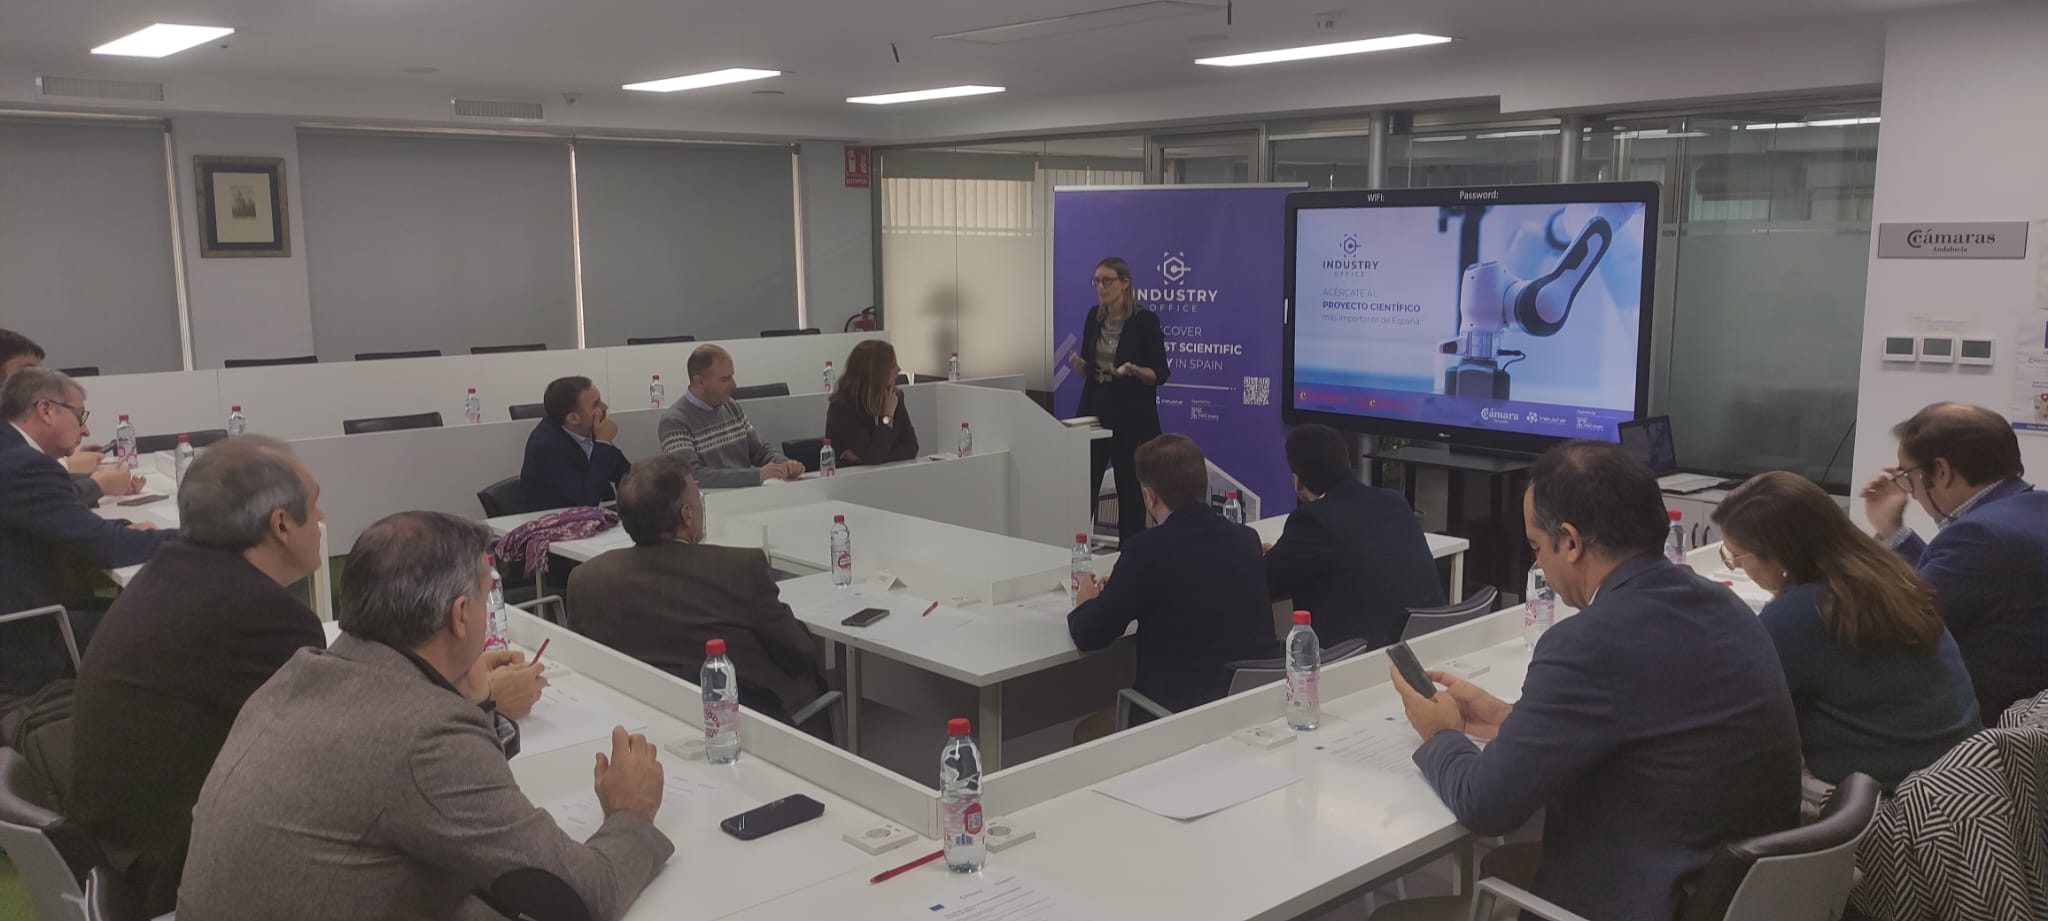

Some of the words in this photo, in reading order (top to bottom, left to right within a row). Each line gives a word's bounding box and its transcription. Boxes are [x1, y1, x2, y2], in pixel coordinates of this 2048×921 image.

[1459, 189, 1499, 200] Password:
[1322, 260, 1379, 270] INDUSTRY
[1133, 288, 1218, 302] INDUSTRY
[1149, 304, 1198, 313] OFFICE
[1322, 301, 1369, 311] PROYECTO
[1370, 300, 1421, 313] CIENTÍFICO
[1160, 325, 1202, 337] COVER
[1179, 342, 1243, 355] SCIENTIFIC
[1175, 359, 1187, 369] IN
[1189, 360, 1223, 371] SPAIN
